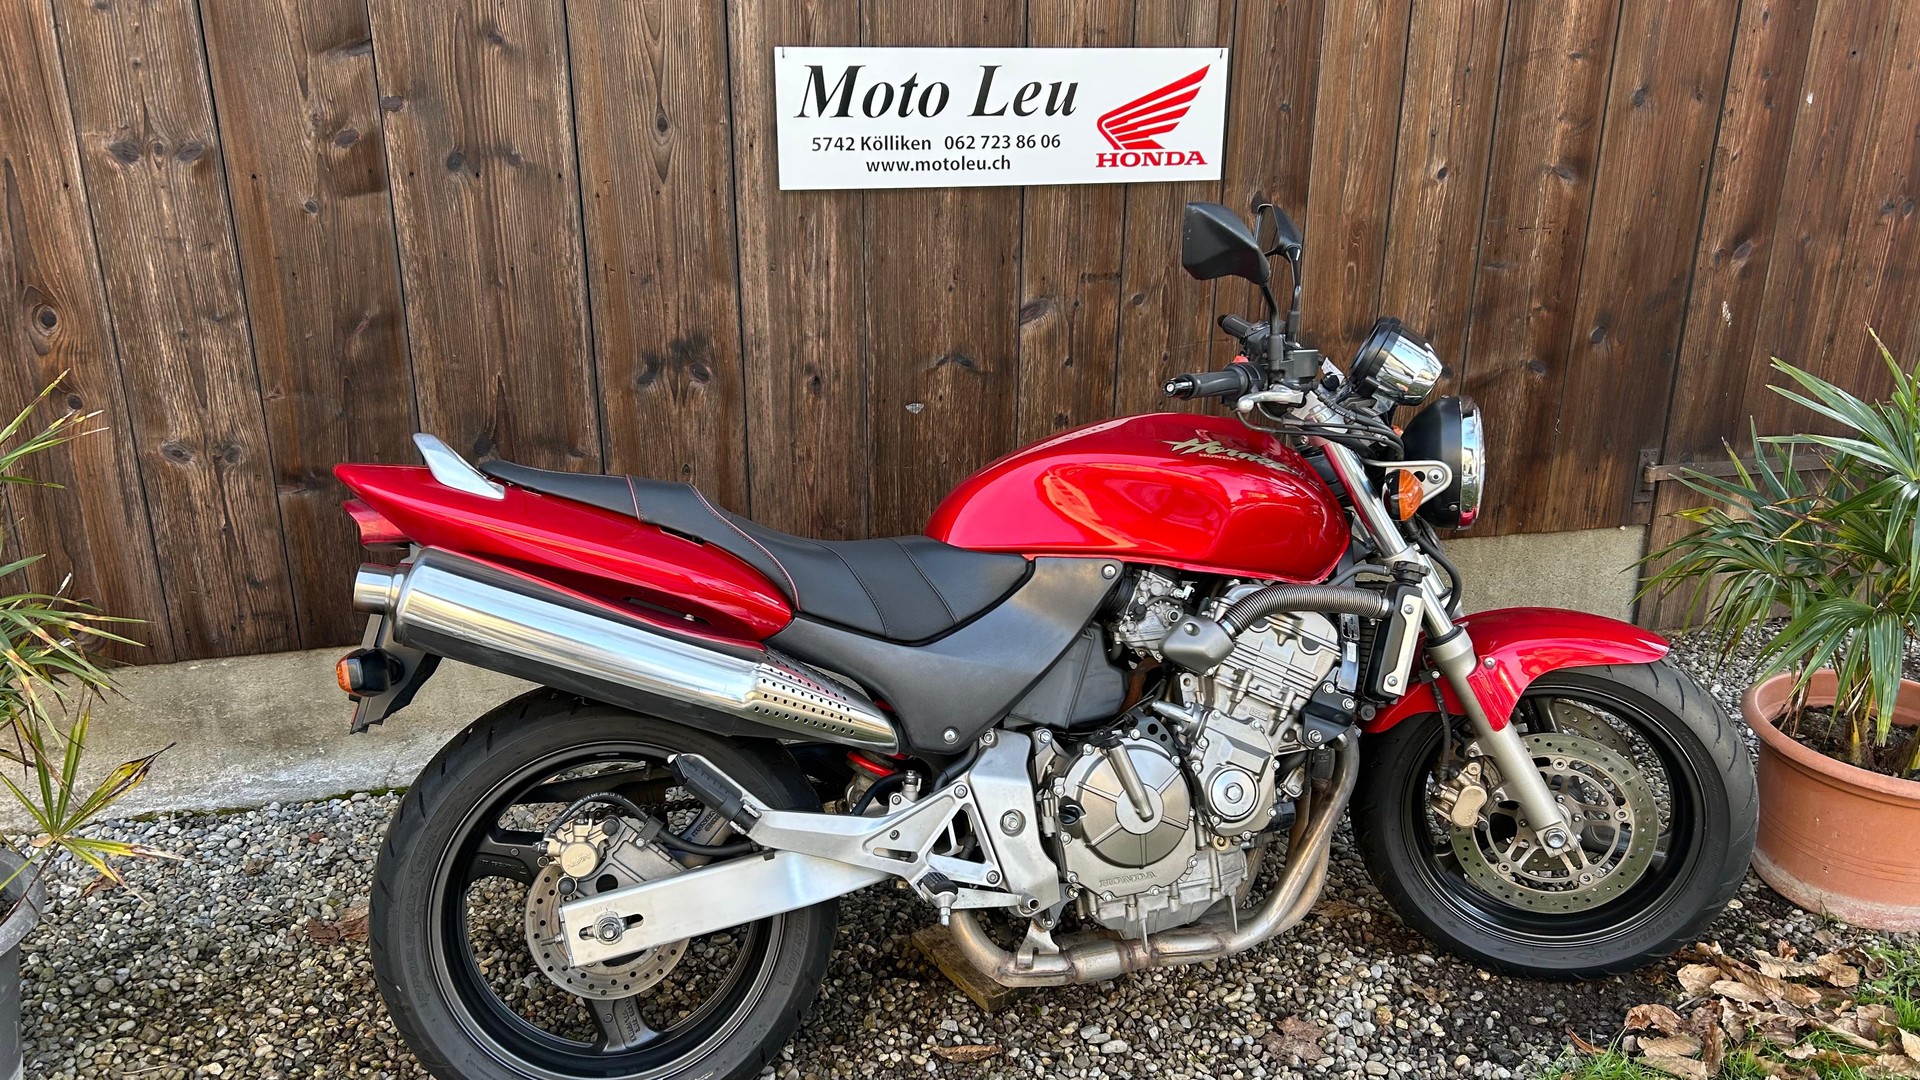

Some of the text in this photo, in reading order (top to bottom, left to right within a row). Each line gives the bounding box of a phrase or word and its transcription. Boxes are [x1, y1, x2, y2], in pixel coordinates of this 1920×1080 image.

[794, 65, 1079, 119] Moto Leu
[812, 133, 1061, 152] 5742 Kölliken 062 723 86 06
[865, 154, 1011, 172] www.motoleu.ch
[1096, 150, 1207, 168] HONDA
[1098, 870, 1157, 888] HONDA
